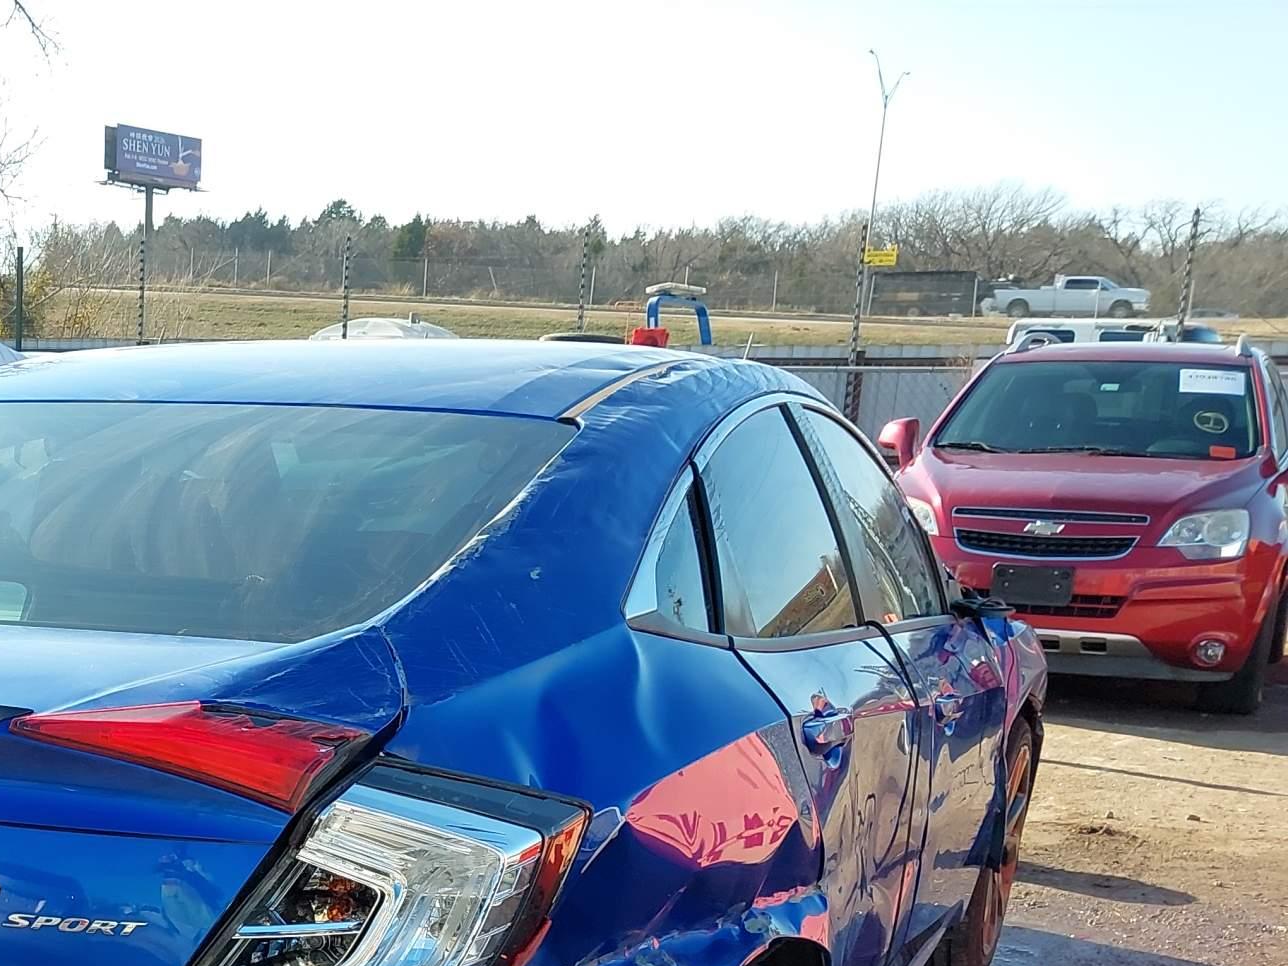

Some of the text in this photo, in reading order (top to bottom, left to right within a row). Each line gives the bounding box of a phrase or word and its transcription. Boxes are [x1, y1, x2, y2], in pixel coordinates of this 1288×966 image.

[122, 138, 149, 153] SHEN
[151, 143, 171, 158] YUN
[2, 913, 148, 937] SPORT
